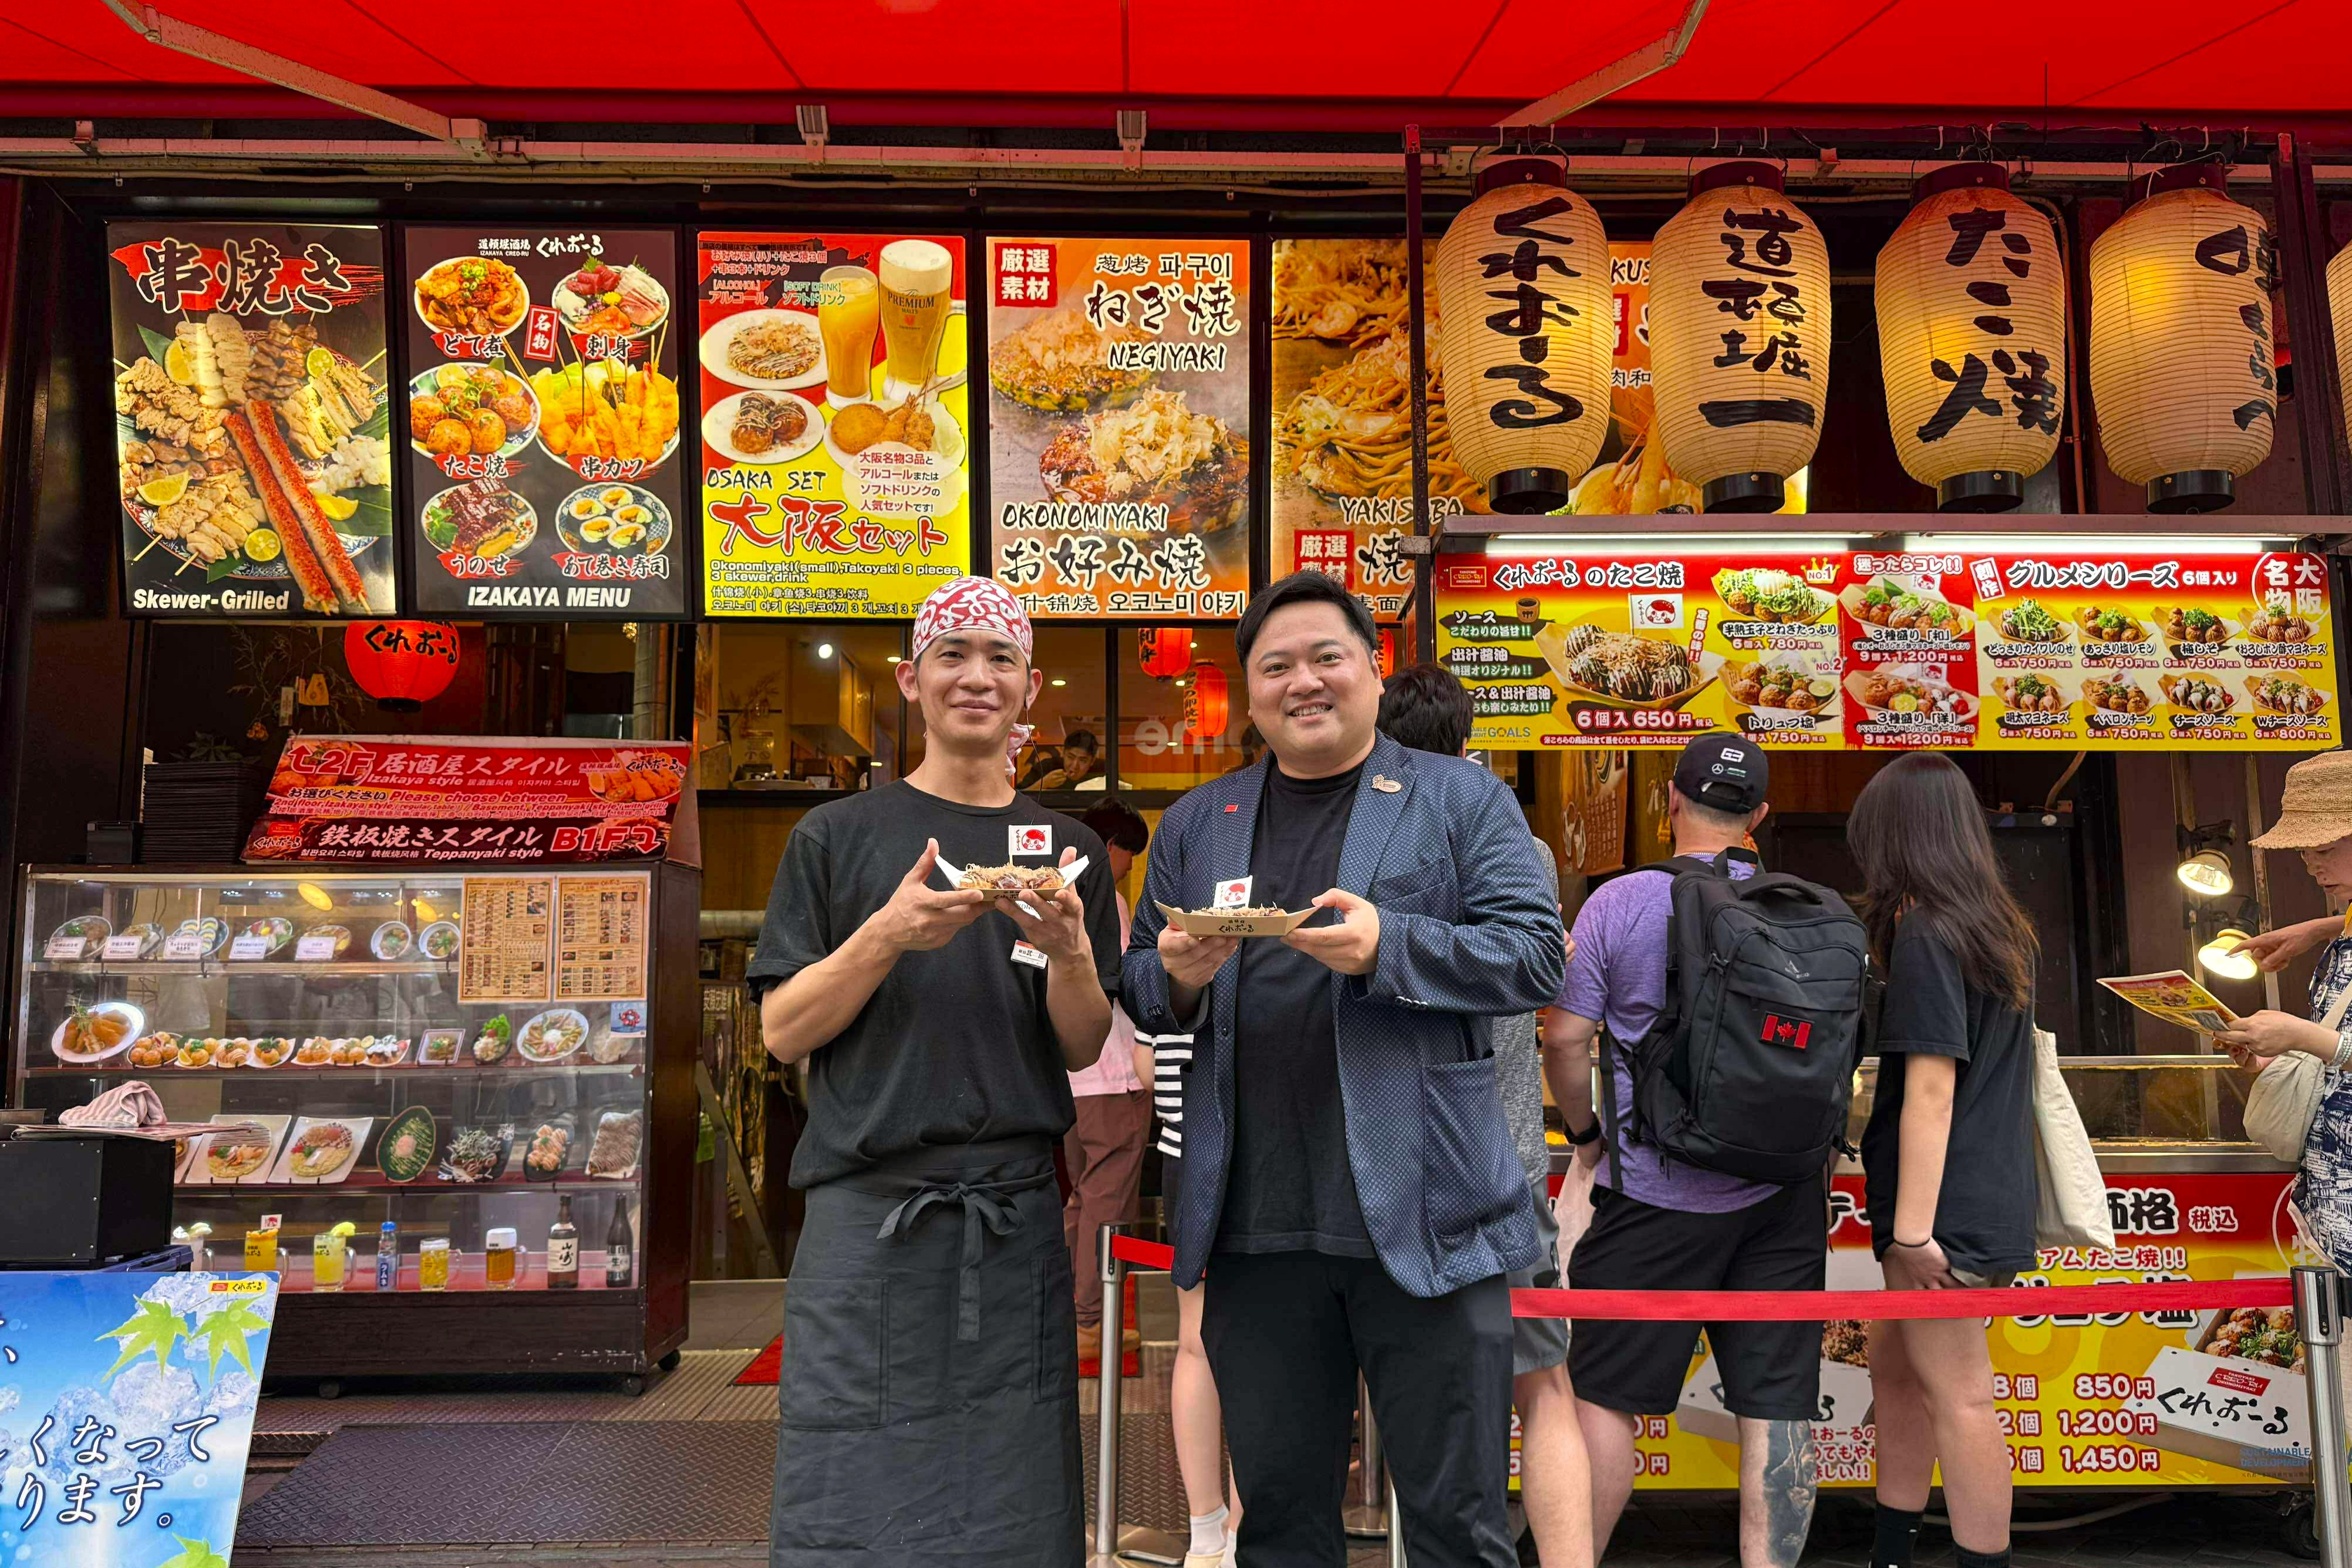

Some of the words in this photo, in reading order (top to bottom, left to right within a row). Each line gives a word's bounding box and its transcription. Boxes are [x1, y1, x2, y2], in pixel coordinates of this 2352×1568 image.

[536, 234, 604, 258] くれおーる
[1001, 248, 1050, 273] 厳選
[1161, 254, 1234, 278] 파구이
[137, 237, 352, 315] 串焼き
[709, 292, 769, 304] アルコール
[782, 293, 846, 306] ソフトドリンク
[888, 291, 935, 308] PREMIUM
[1001, 276, 1050, 301] 素材
[1086, 284, 1242, 336] ねぎ焼
[1478, 197, 1583, 429] くれおーる
[532, 314, 551, 350] 名物
[1916, 207, 2062, 443] たこ焼
[444, 335, 506, 358] どて煮
[587, 336, 633, 359] 刺身
[1108, 343, 1227, 371] NEGIYAKI
[446, 455, 508, 478] たこ焼
[582, 456, 645, 479] 串カツ
[860, 453, 934, 465] 大阪名物3品と
[707, 470, 772, 490] OSAKA
[788, 471, 826, 491] SET
[860, 467, 939, 481] アルコールまたは
[860, 484, 940, 497] ソフトドリンクの
[1003, 504, 1167, 530] OKONOMIYAKI
[1340, 497, 1463, 524] YAKISBA
[709, 493, 948, 556] 大阪セット
[1300, 535, 1347, 558] 厳選
[451, 555, 510, 575] うのせ
[564, 556, 669, 578] あて巻き寿司
[904, 564, 912, 574] 3
[998, 534, 1210, 588] お好み焼
[1856, 557, 1961, 573] 迷ったらコレ!!
[711, 572, 719, 581] 3
[1494, 559, 1580, 589] くれおーる
[1586, 561, 1684, 588] のたこ焼
[1975, 562, 2000, 596] 創作
[2008, 562, 2177, 586] グルメシリーズ
[2182, 571, 2237, 586] 6個入り
[133, 589, 290, 611] Skewer-Grilled
[468, 587, 560, 606] IZAKAYA
[567, 588, 631, 607] MENU
[712, 601, 756, 611] 오코노미
[1108, 593, 1194, 615] 오코노미
[1202, 592, 1245, 615] 야키
[1454, 611, 1497, 623] ソース
[365, 624, 458, 663] くれおーる
[1451, 648, 1508, 662] 出汁醤油
[1578, 710, 1629, 727] 6個入
[2175, 715, 2235, 727] チーズソース
[1488, 727, 1531, 737] GOALS
[378, 752, 571, 777] 居酒屋スタイル
[367, 774, 424, 785] Izakaya
[428, 776, 464, 786] style
[289, 788, 387, 800] お選びください
[390, 790, 440, 802] Please
[444, 791, 497, 803] choose
[500, 791, 568, 803] between
[319, 825, 543, 848] 鉄板焼きスタイル
[550, 827, 631, 852] B1F
[424, 849, 506, 860] Teppanyaki
[508, 849, 543, 858] style
[2191, 1208, 2236, 1230] 税込
[2075, 1376, 2155, 1399] 850円
[2228, 1372, 2255, 1381] TAKOYAKI
[2157, 1388, 2288, 1434] くれおーる
[2059, 1411, 2157, 1436] 1,200円
[2062, 1449, 2160, 1471] 1,450円
